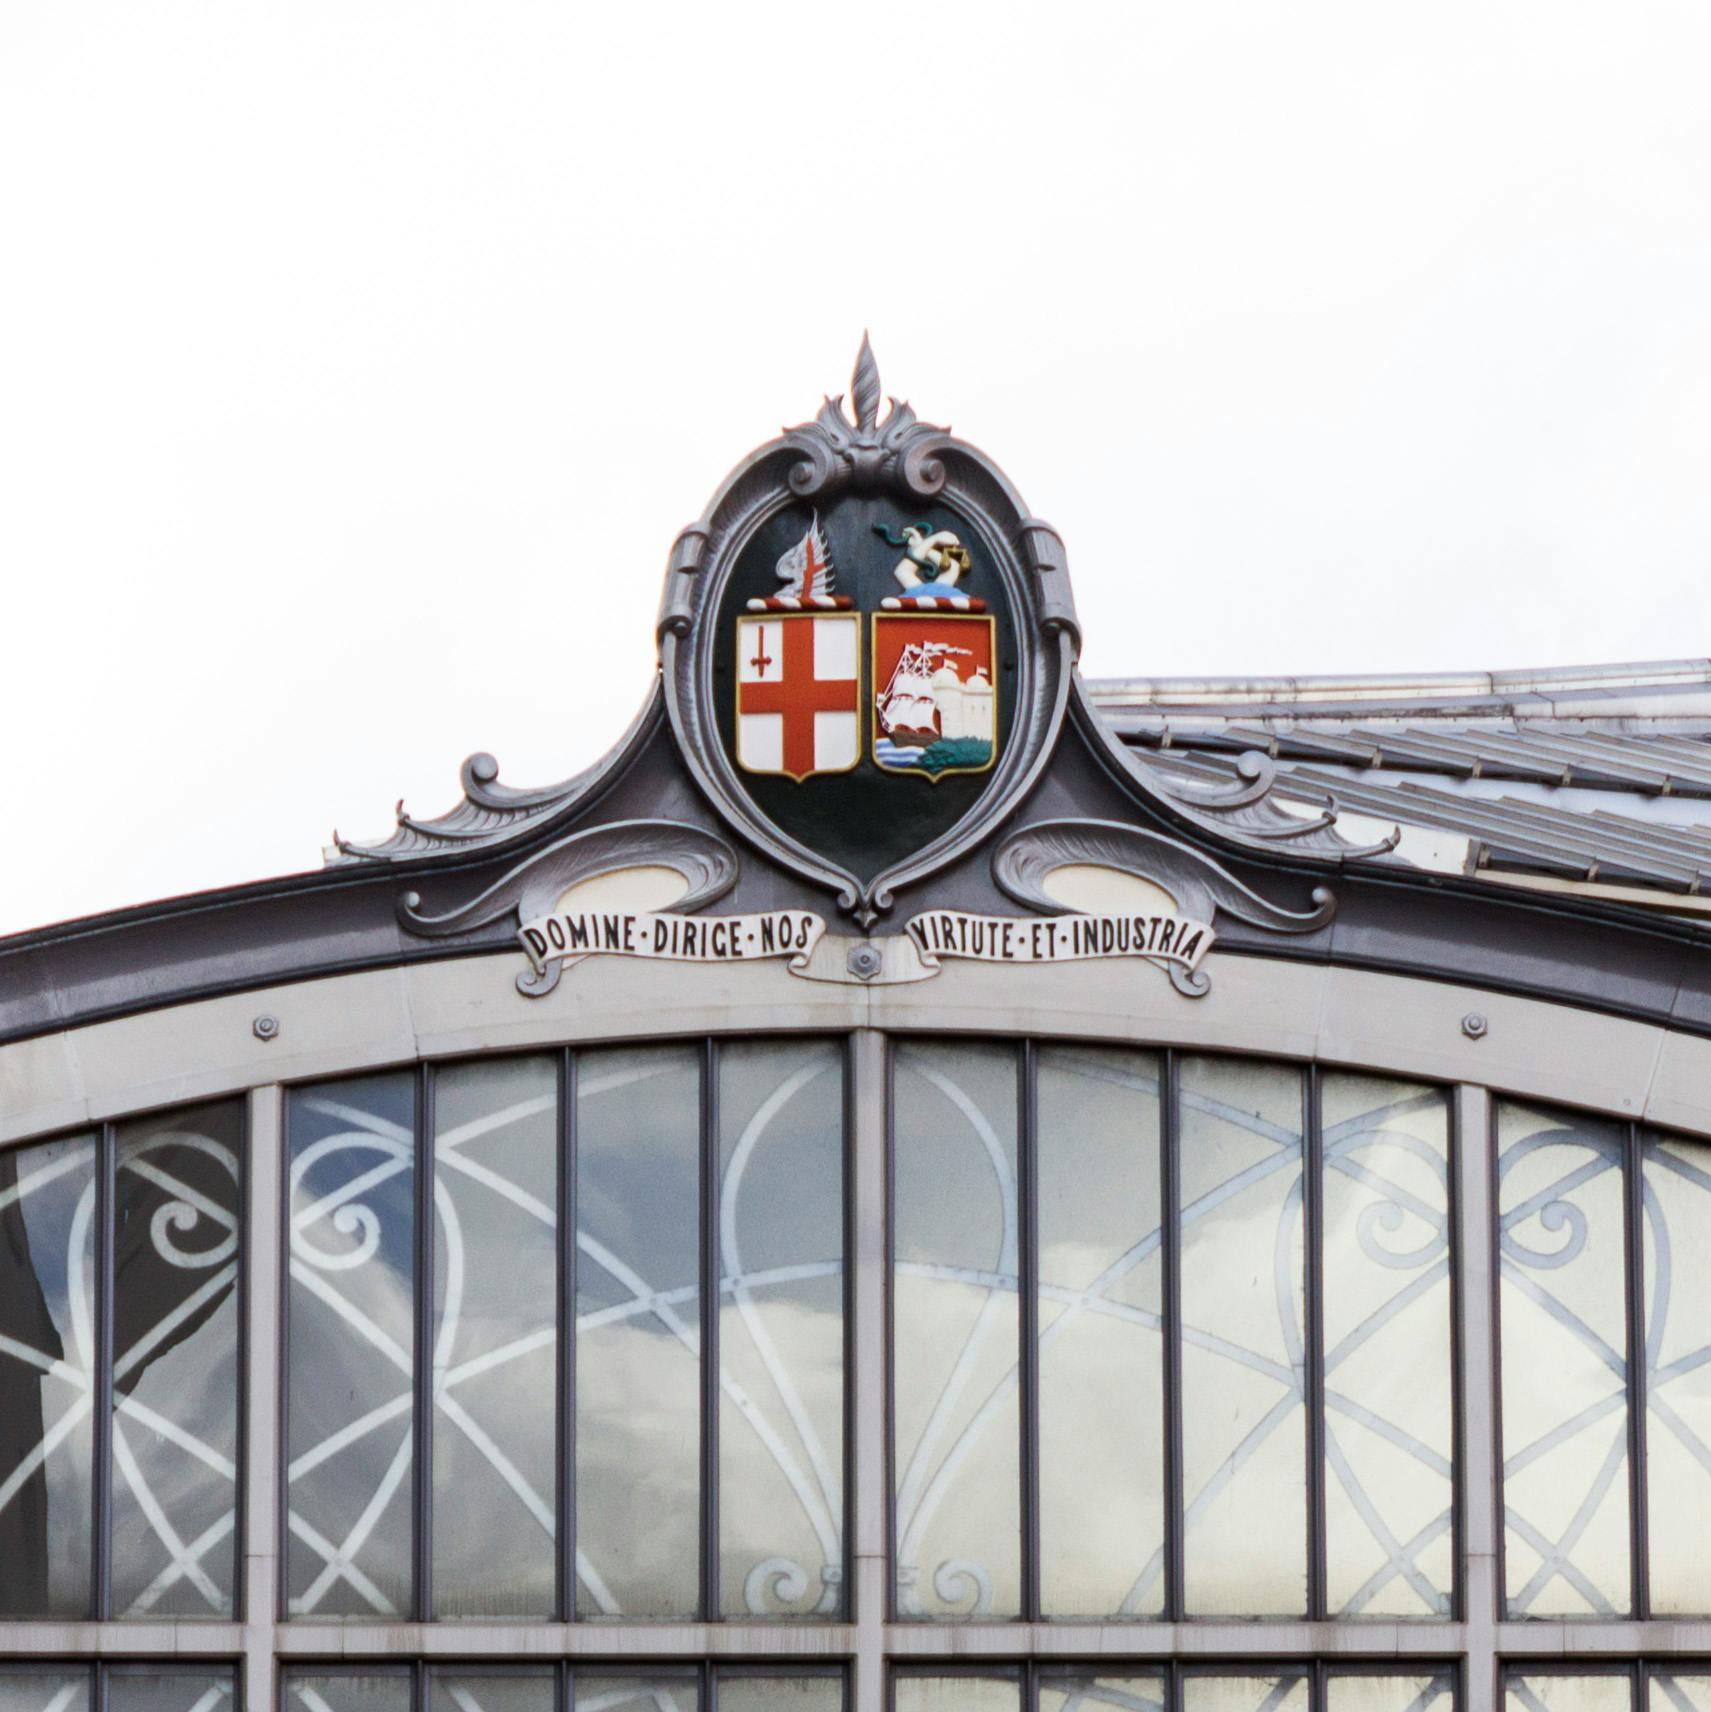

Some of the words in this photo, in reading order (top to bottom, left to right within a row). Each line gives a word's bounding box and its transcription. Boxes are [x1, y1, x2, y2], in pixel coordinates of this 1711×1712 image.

[522, 914, 637, 959] DOMINE
[654, 918, 743, 958] DIRIGE
[760, 914, 813, 957] NOS
[910, 915, 1014, 959] VIRTUTE
[1031, 922, 1057, 959] ET
[1072, 916, 1204, 961] INDUSTRIA
